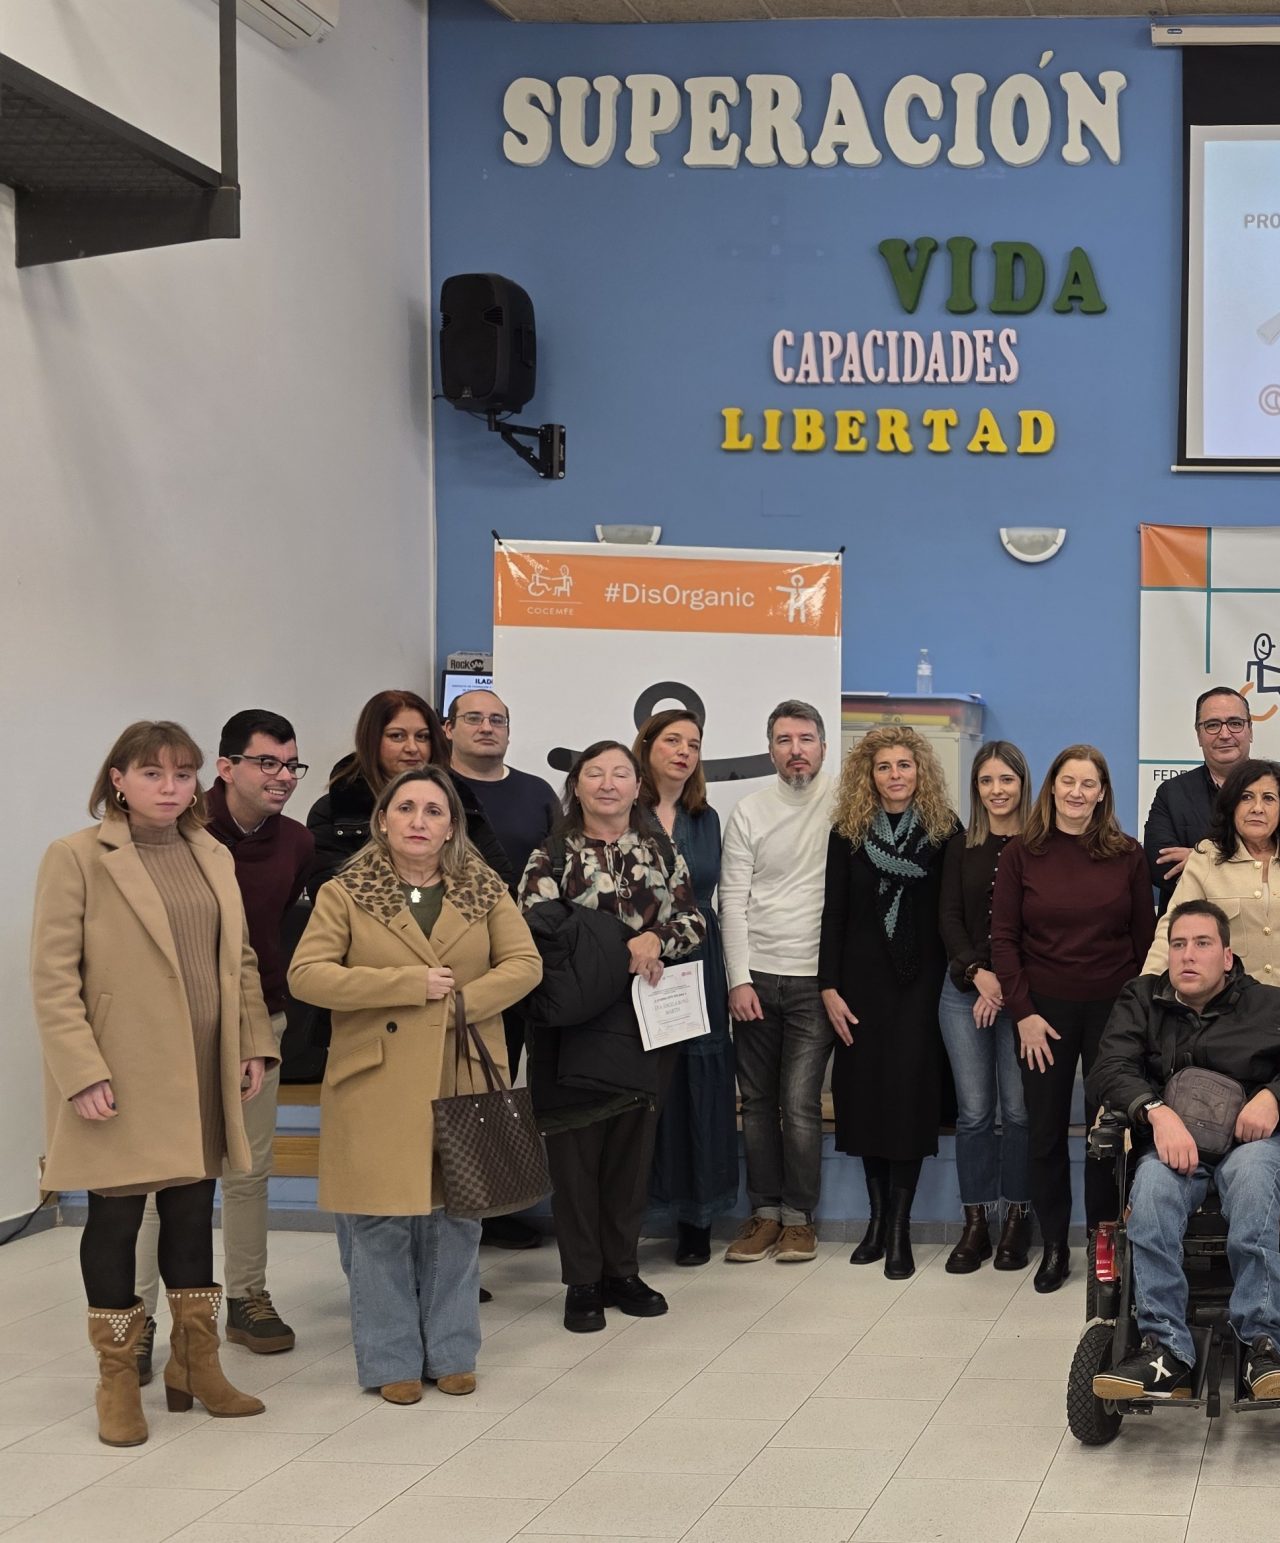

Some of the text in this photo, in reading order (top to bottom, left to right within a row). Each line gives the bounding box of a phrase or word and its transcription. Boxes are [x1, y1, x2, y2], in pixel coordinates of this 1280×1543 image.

[503, 50, 1127, 168] SUPERACIÓN
[877, 236, 1107, 314] VIDA
[772, 328, 1019, 384] CAPACIDADES
[721, 407, 1056, 455] LIBERTAD
[526, 606, 574, 616] COCEMFE
[604, 582, 755, 611] #DisOrganic
